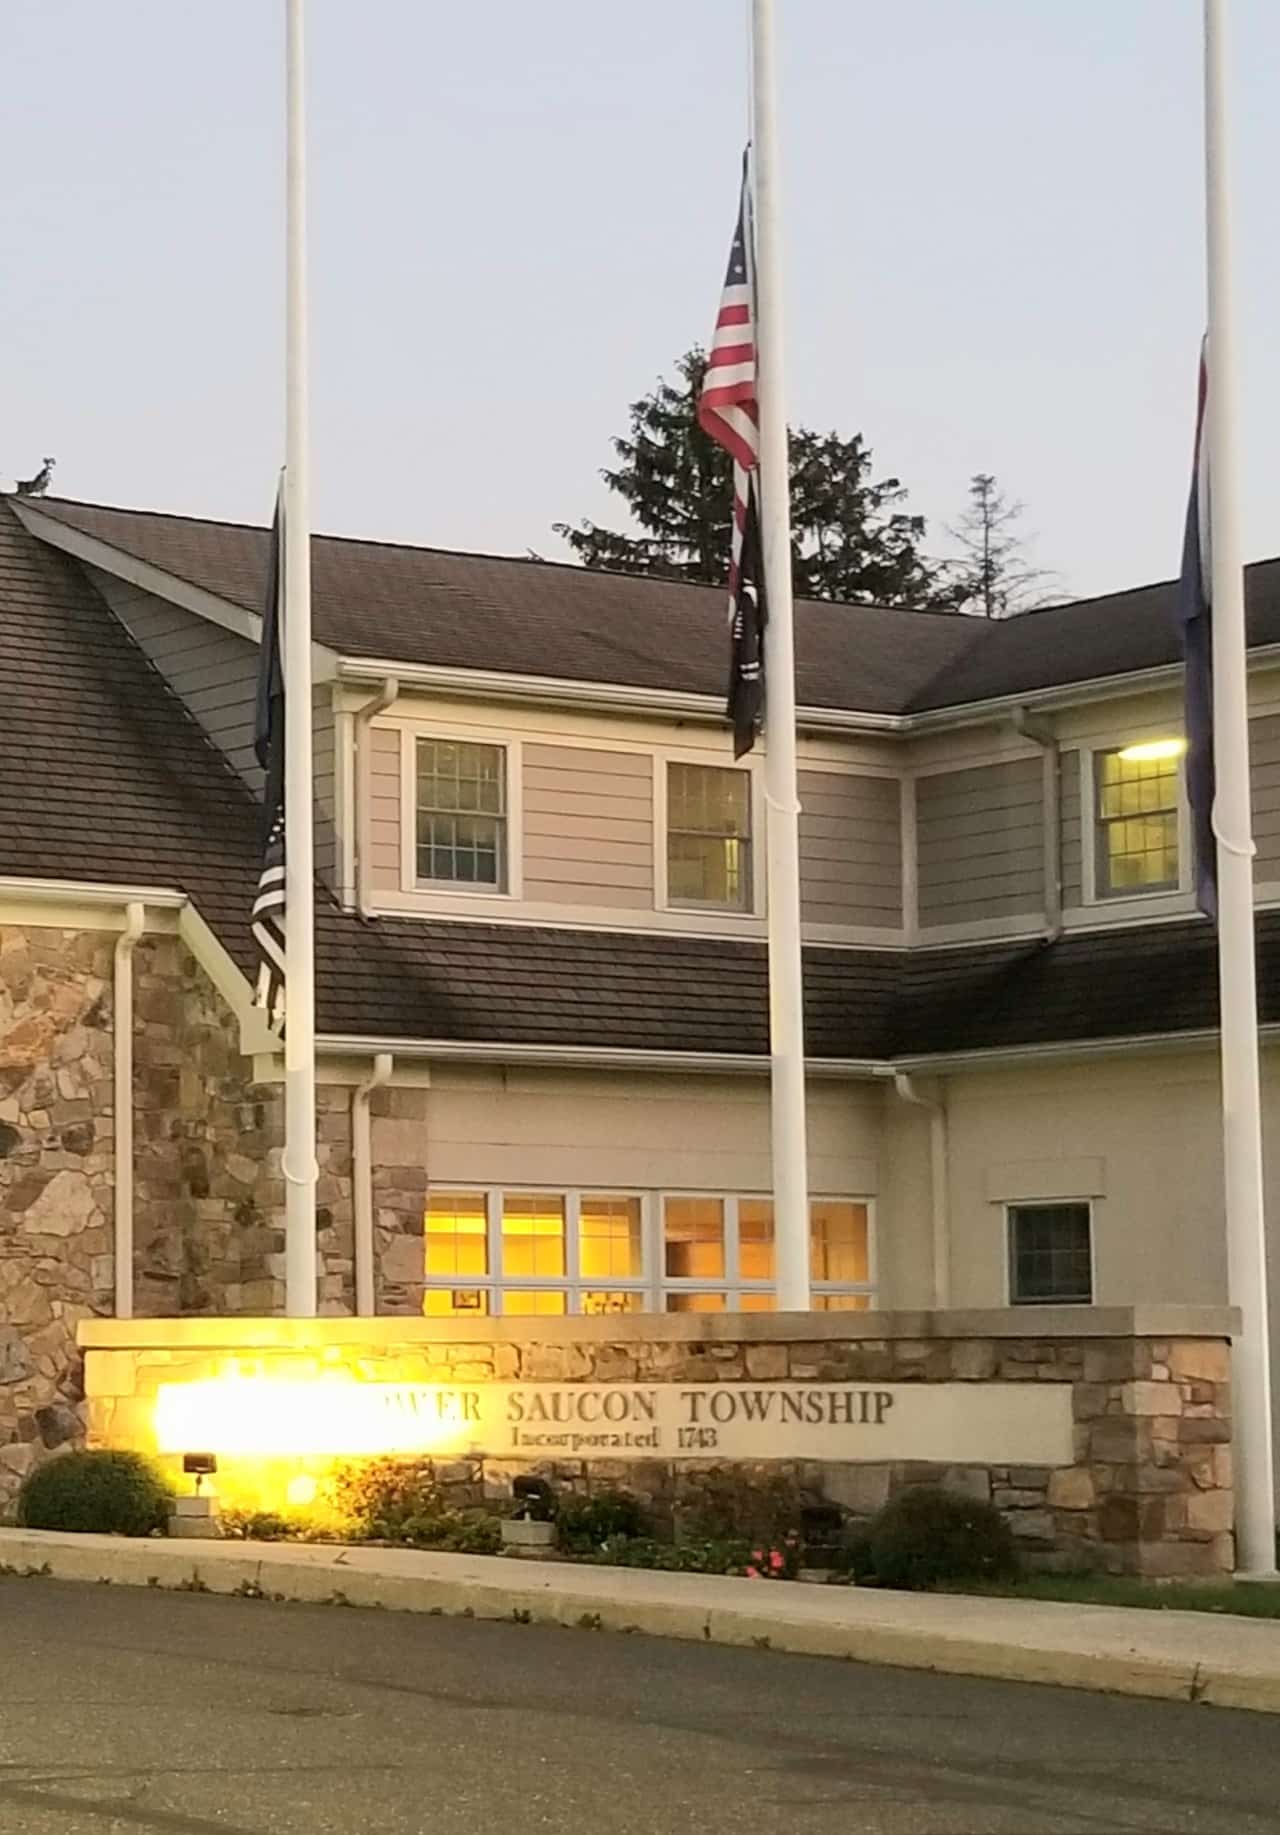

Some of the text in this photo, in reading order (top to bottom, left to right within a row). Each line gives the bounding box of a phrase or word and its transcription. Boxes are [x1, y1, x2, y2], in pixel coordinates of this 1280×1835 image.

[384, 1390, 895, 1425] WER SAUCON TOWNSHIP
[511, 1426, 718, 1451] Incorporated 1743
